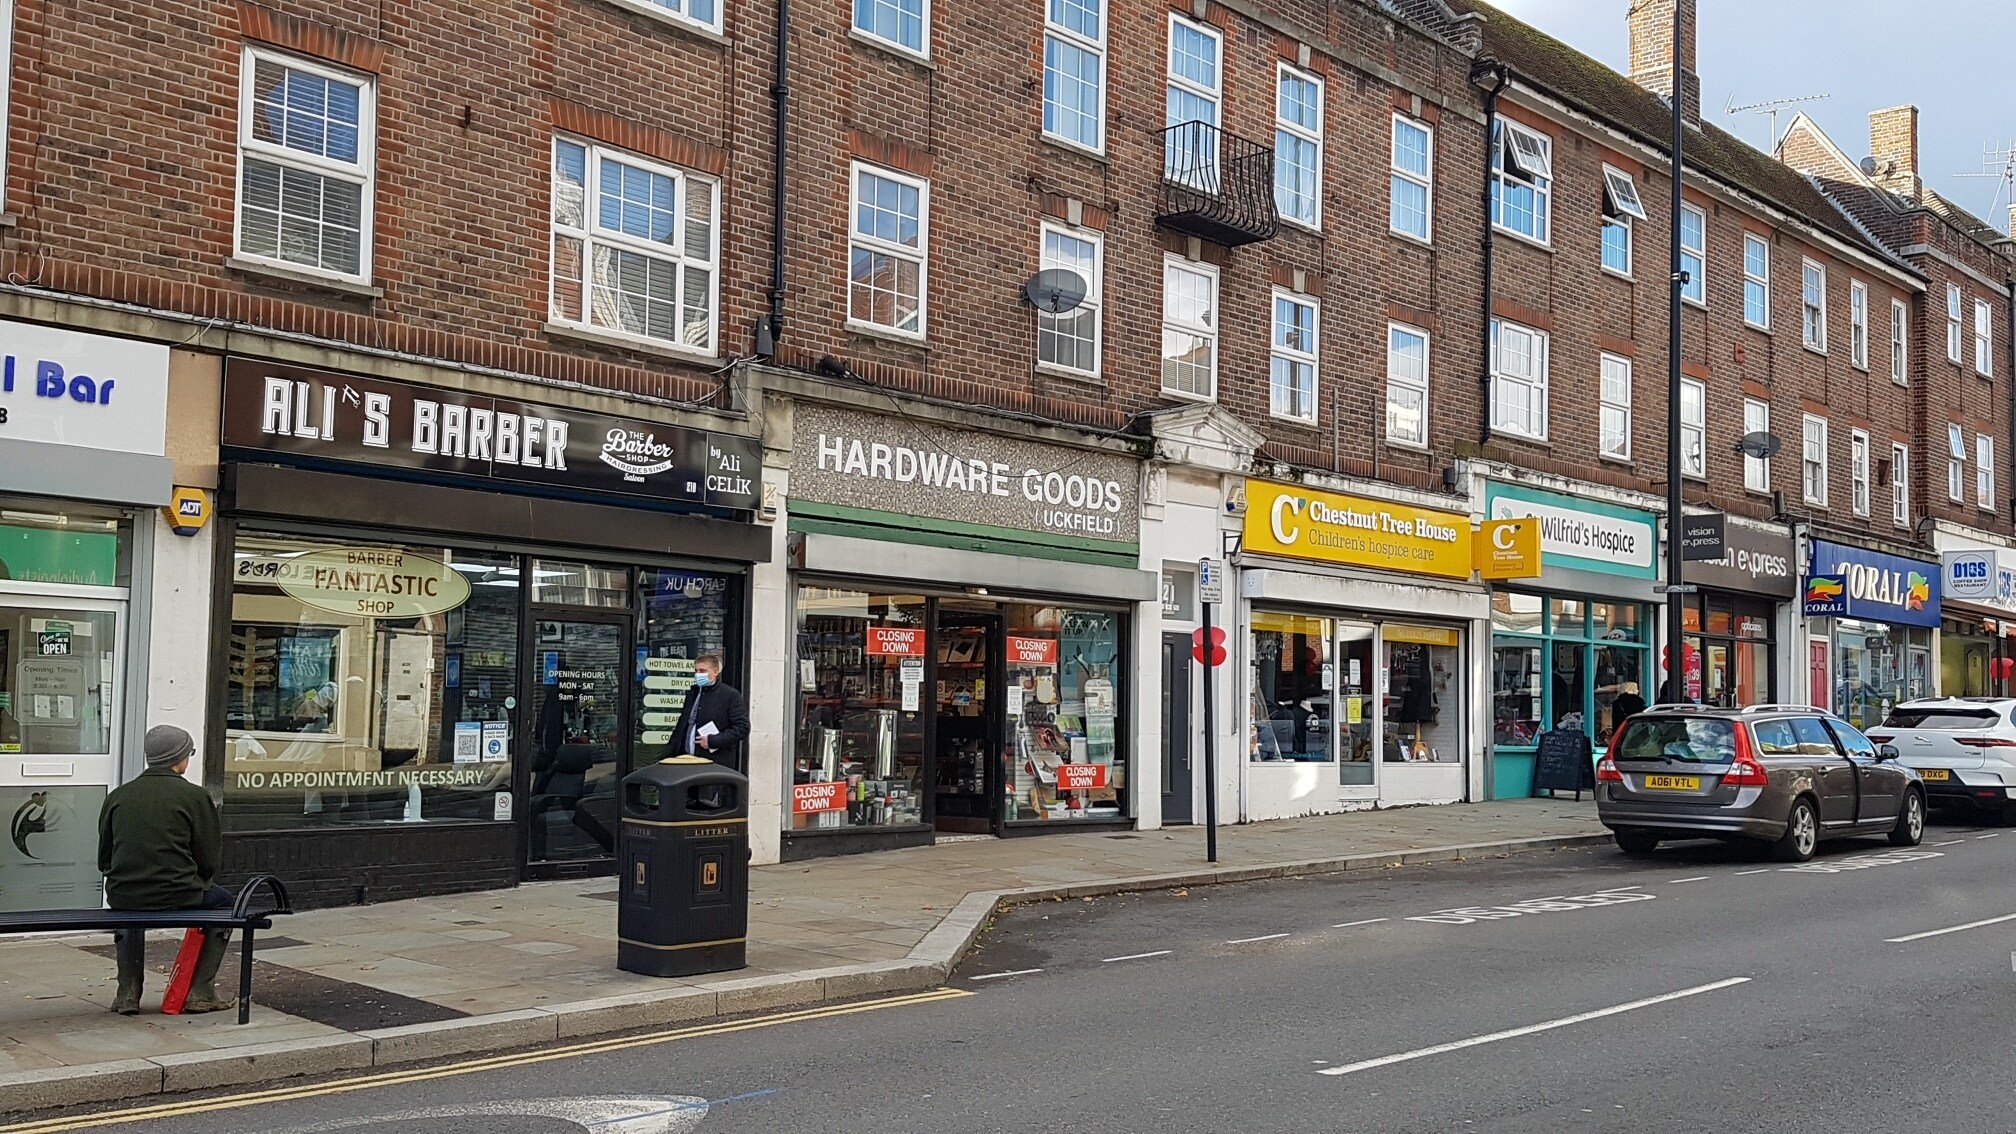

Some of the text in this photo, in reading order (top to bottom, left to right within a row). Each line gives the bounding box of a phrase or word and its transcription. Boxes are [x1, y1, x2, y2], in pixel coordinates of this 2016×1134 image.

[36, 359, 115, 405] Bar
[261, 376, 569, 471] ALI'S BARBER
[628, 431, 645, 441] THE
[602, 428, 674, 458] Barber
[626, 453, 649, 463] SHOP
[710, 445, 721, 459] by
[605, 455, 668, 475] HAIRDRESSING
[719, 454, 741, 472] Ali
[817, 433, 1122, 513] HARDWARE GOODS
[180, 500, 202, 514] ADT
[1309, 499, 1457, 543] Chestnut Tree House
[1541, 515, 1635, 556] Wilfrid's Hospice
[1687, 527, 1715, 536] vision
[1308, 528, 1435, 562] Children's hospice care
[1682, 537, 1720, 547] express
[347, 551, 403, 568] BARBER
[1737, 549, 1787, 579] express
[314, 568, 438, 597] FANTASTIC
[356, 599, 395, 614] SHOP
[1805, 603, 1844, 612] CORAL
[876, 630, 915, 642] CLOSING
[43, 643, 67, 655] OPEN
[882, 641, 909, 653] DOWN
[1015, 640, 1048, 652] CLOSING
[1020, 651, 1043, 661] DOWN
[663, 661, 685, 669] TOWEL
[548, 670, 606, 679] OPENING HOURS
[558, 682, 576, 690] MON
[582, 682, 595, 690] SAT
[671, 679, 683, 687] DRY
[558, 693, 574, 701] 9am
[579, 693, 594, 703] 6pm
[660, 697, 679, 705] WASH
[1066, 766, 1097, 777] CLOSING
[1927, 770, 1944, 778] DXG
[237, 773, 265, 788] NO
[399, 770, 484, 786] NECESSARY
[1070, 777, 1093, 787] DOWN
[1674, 778, 1693, 788] VTL
[794, 784, 836, 799] CLOSING
[800, 797, 830, 811] DOWN
[695, 827, 729, 836] LITTER
